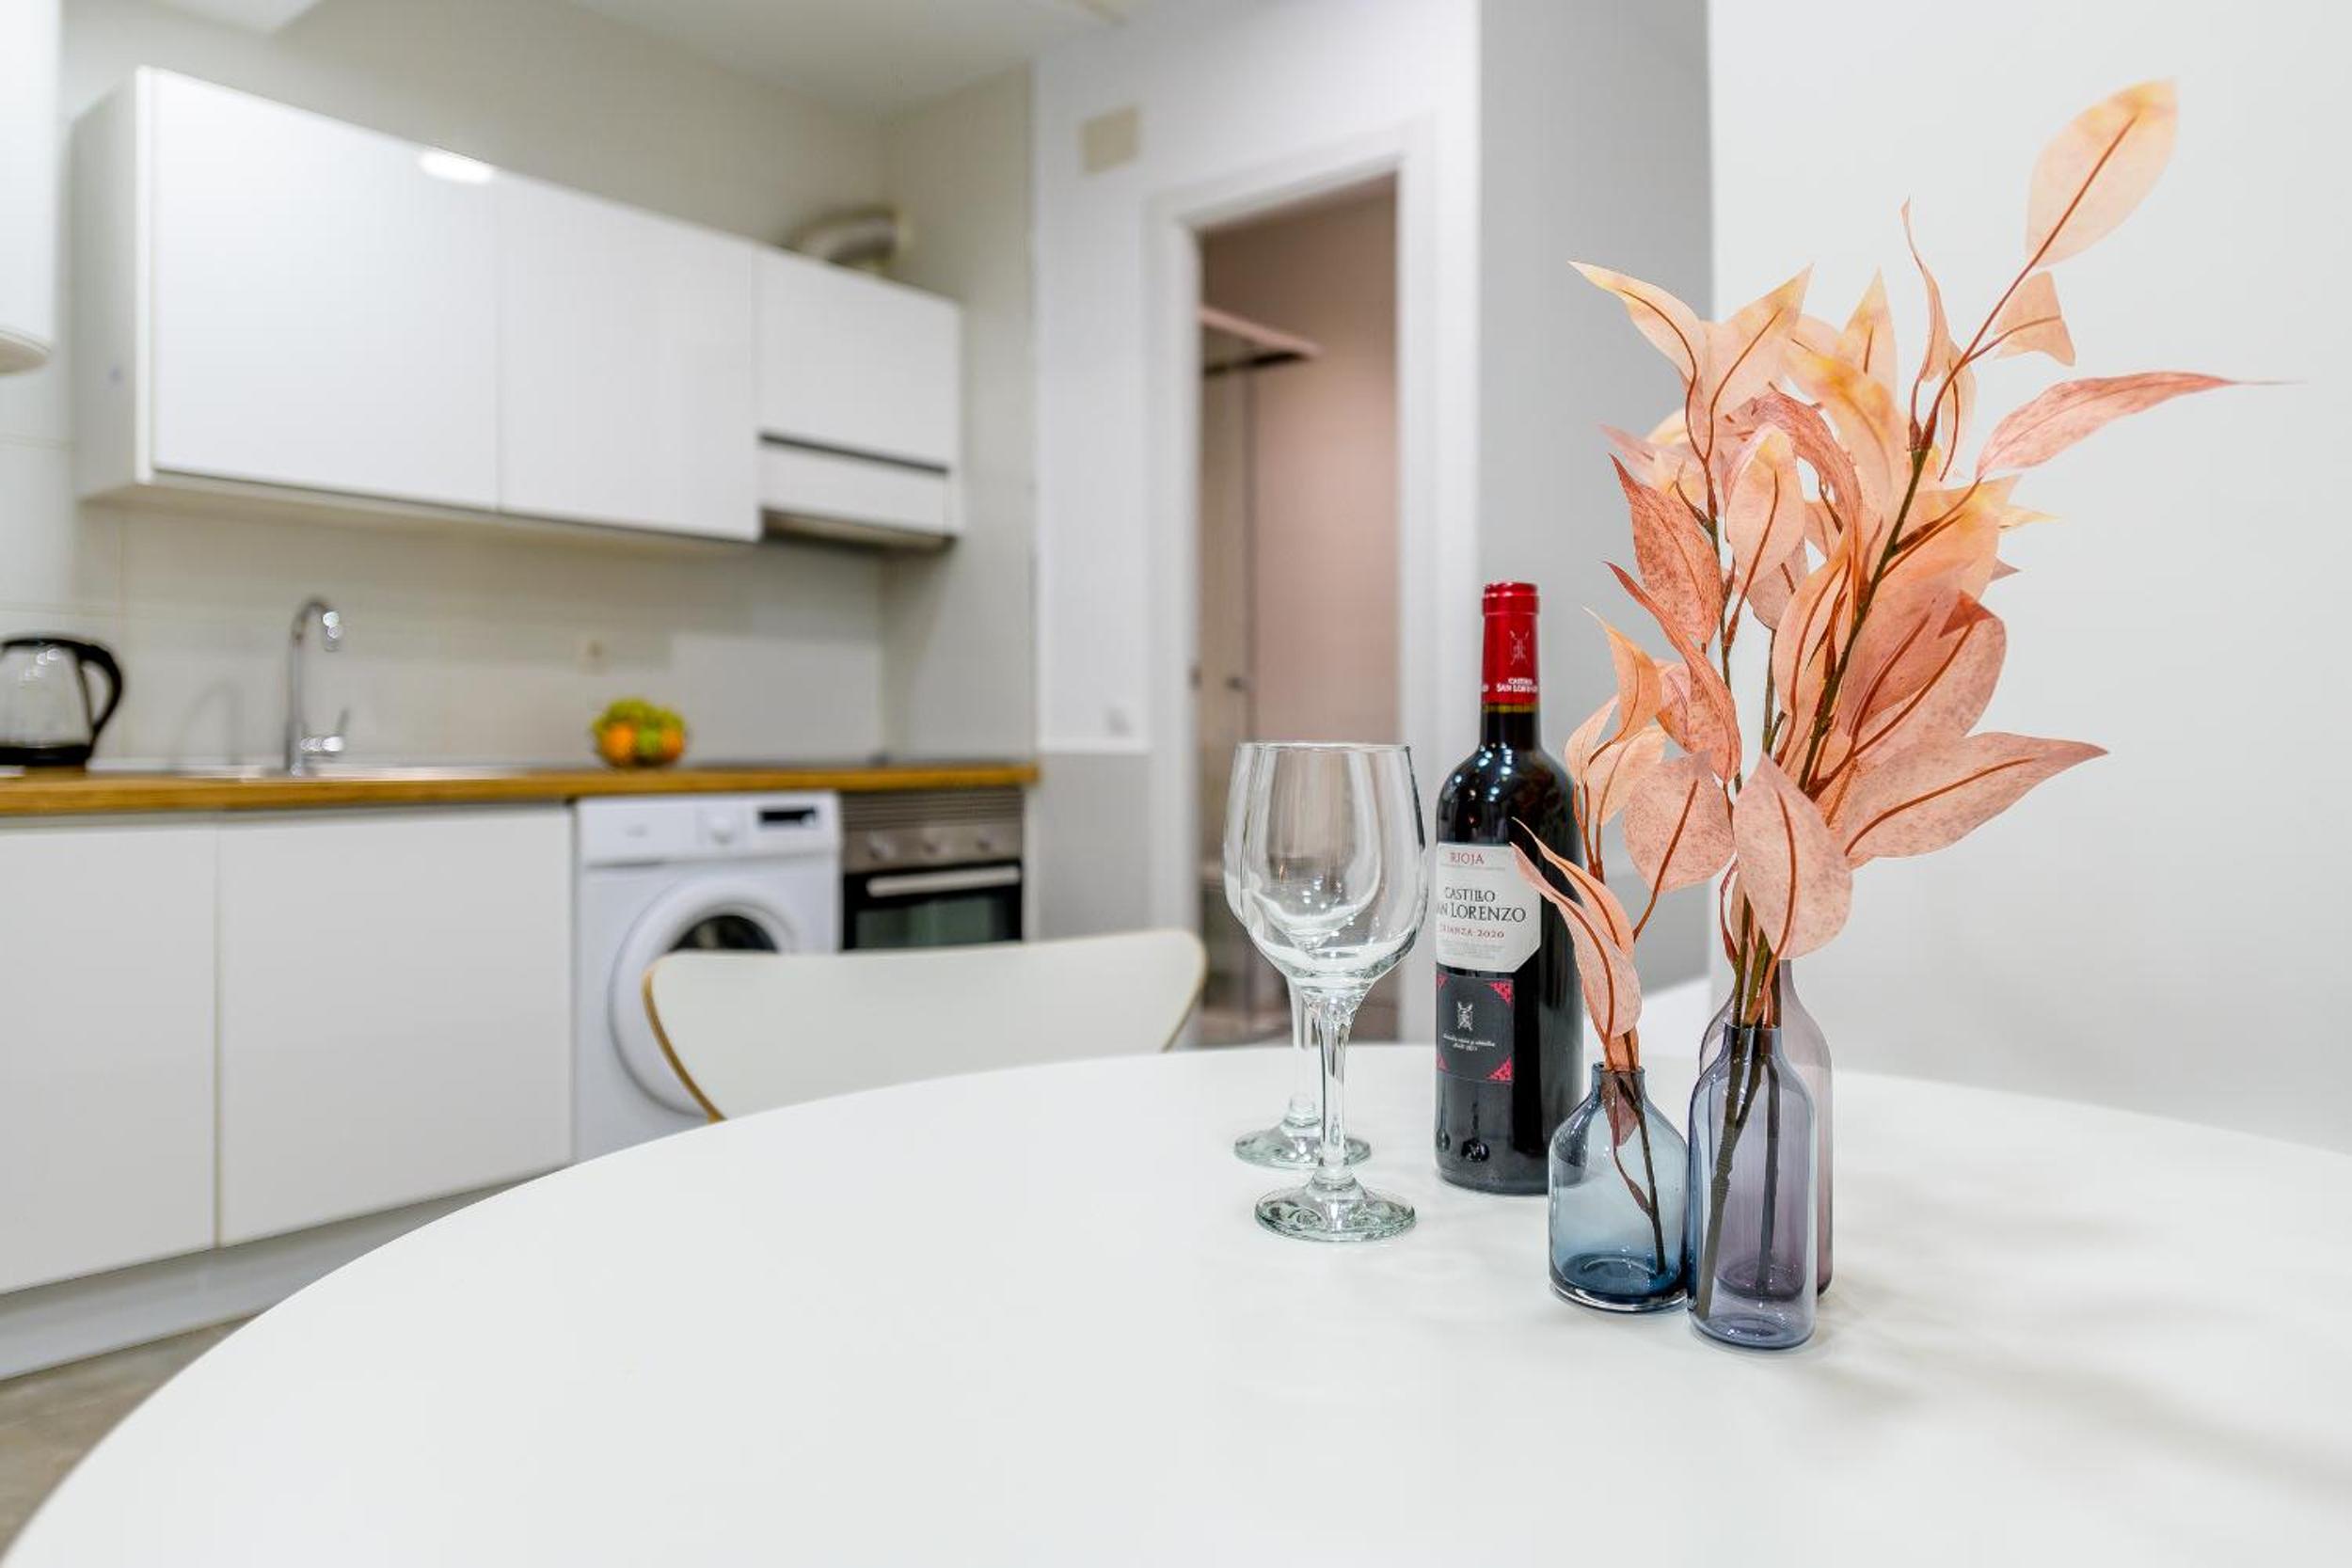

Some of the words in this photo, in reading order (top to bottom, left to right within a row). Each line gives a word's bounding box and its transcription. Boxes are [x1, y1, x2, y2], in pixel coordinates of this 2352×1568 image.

[1450, 851, 1485, 864] RIOJA
[1444, 887, 1496, 903] CASTILLO
[1452, 902, 1526, 923] LORENZO
[1476, 928, 1505, 939] 2020
